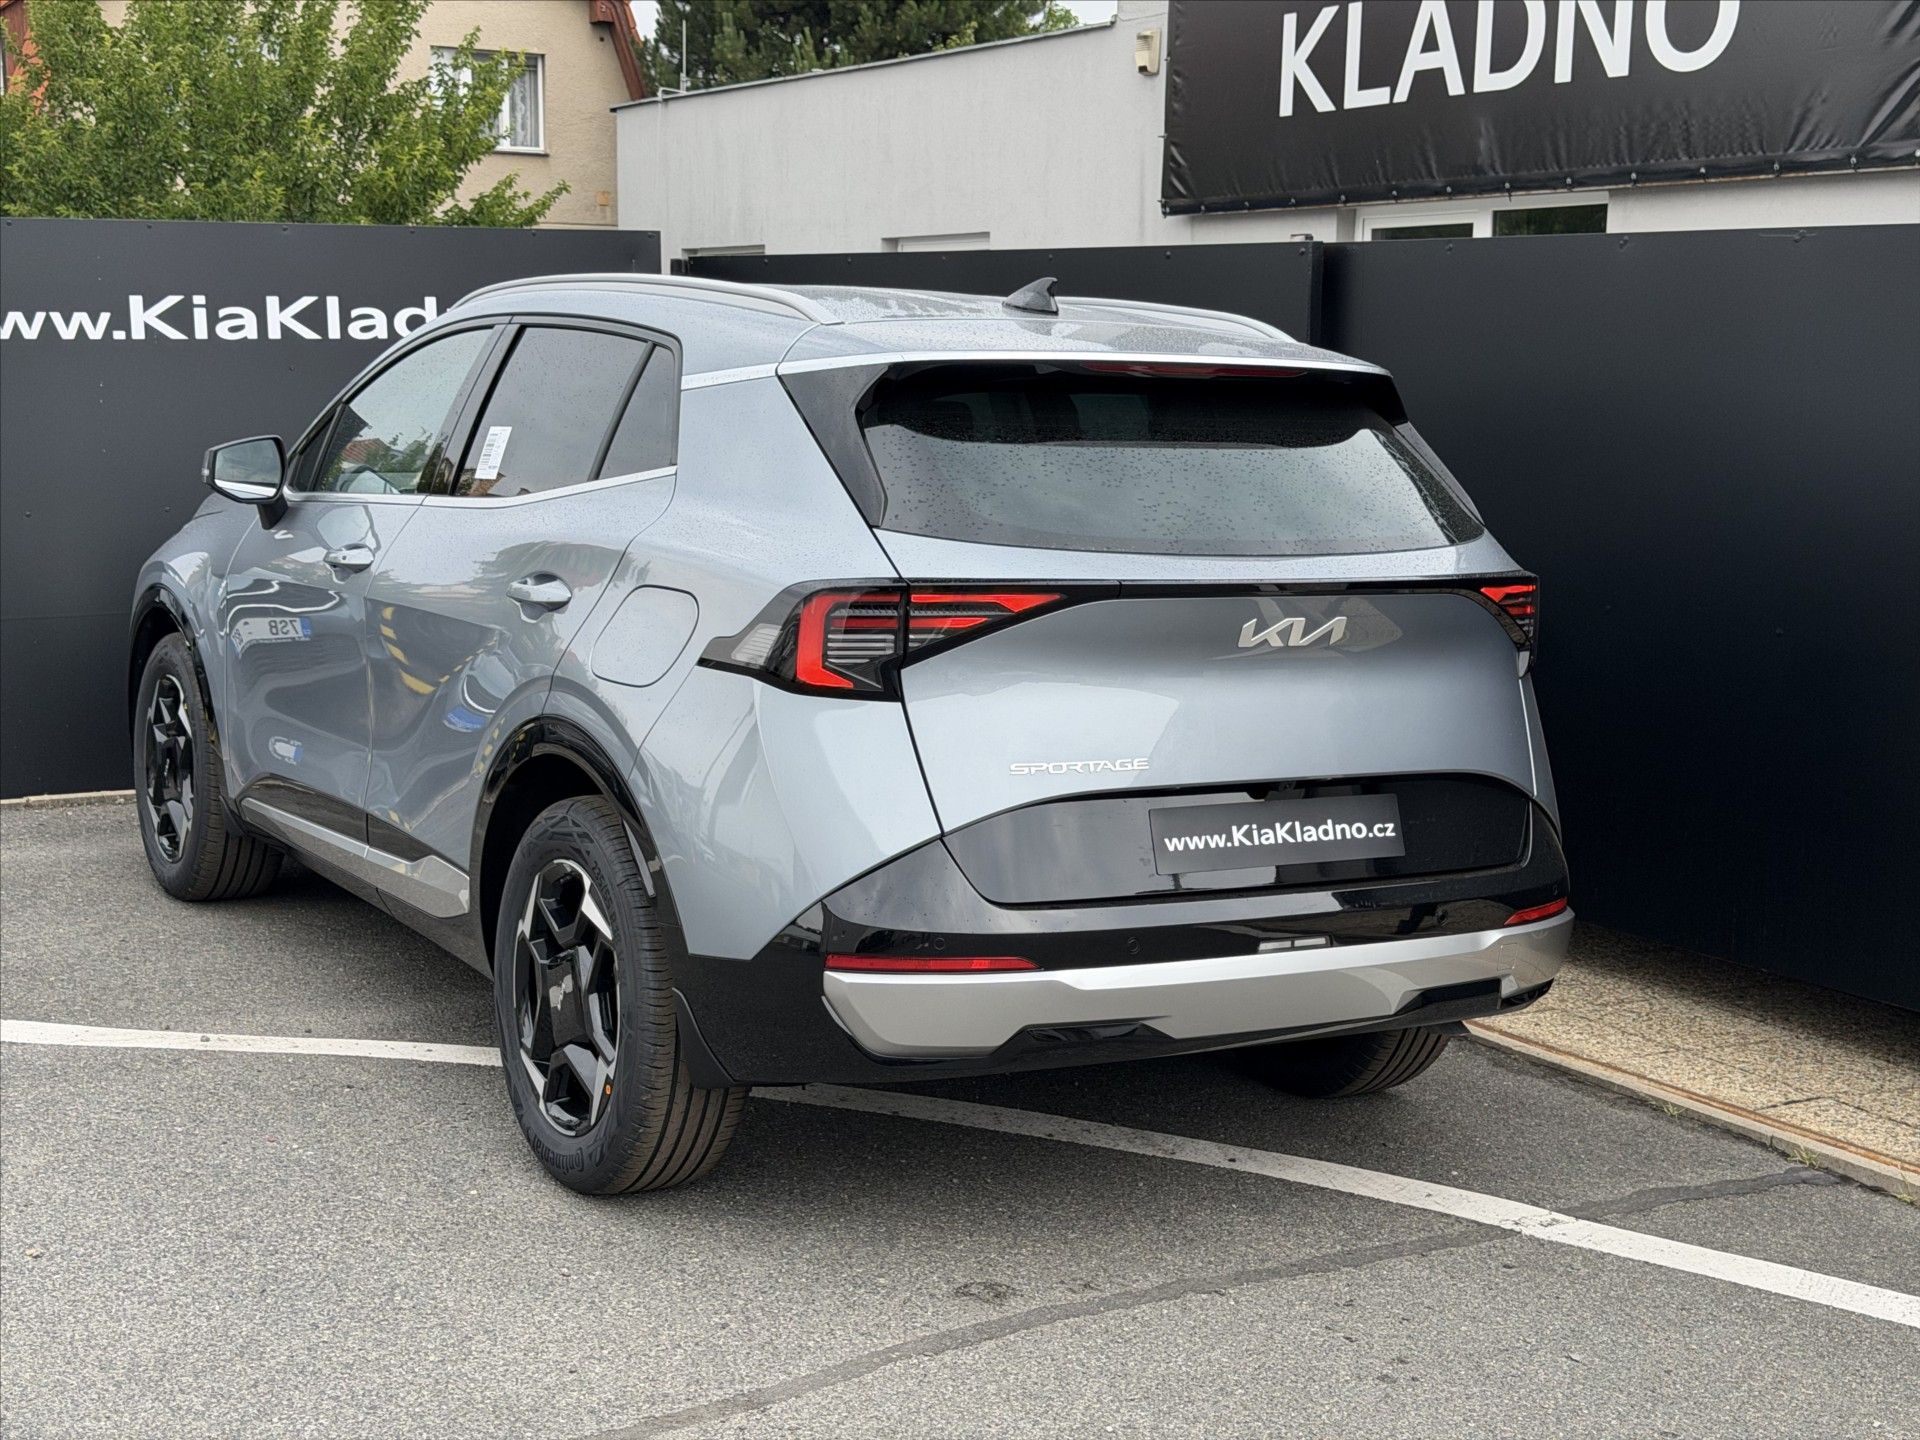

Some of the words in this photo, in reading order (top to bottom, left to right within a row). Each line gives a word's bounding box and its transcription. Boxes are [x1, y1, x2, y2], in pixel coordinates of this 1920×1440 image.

[1278, 0, 1741, 117] KLADNO
[0, 294, 450, 341] ww.KiaKlad
[1009, 757, 1150, 776] SPORTAGE
[1163, 819, 1397, 853] www.KiaKladno.cz
[533, 1134, 585, 1175] Continental
